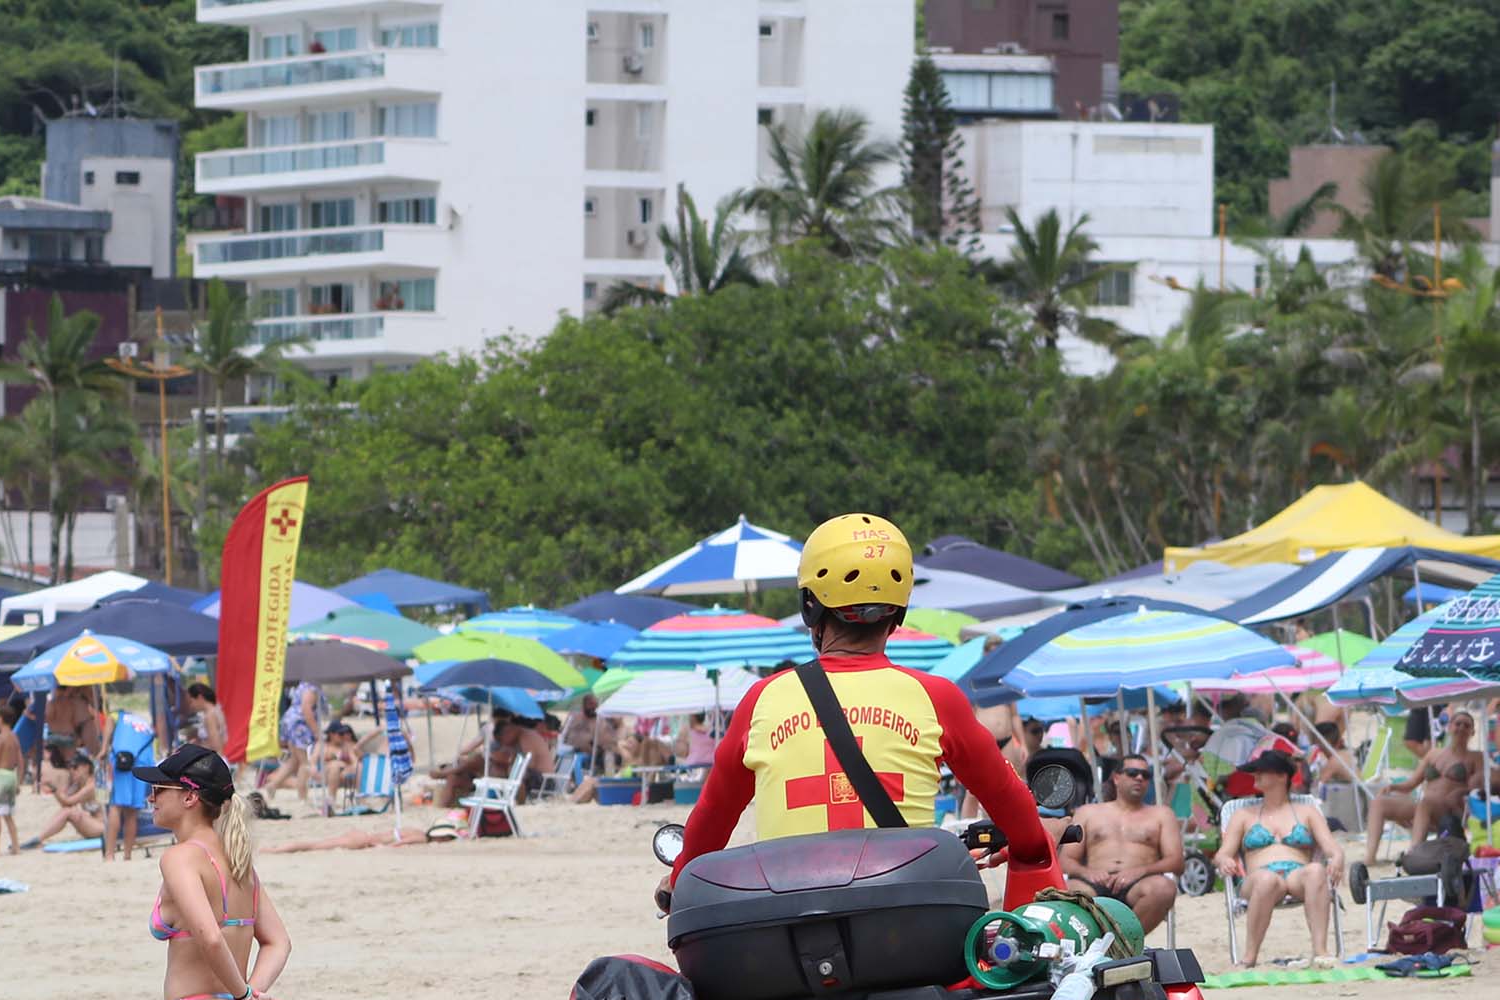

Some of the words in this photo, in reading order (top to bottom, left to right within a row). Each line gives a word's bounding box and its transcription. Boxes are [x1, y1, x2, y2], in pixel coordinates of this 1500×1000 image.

[852, 529, 891, 541] MAS
[864, 545, 886, 559] 27
[263, 564, 281, 673] PROTEGIDA
[769, 711, 811, 751] CORPO
